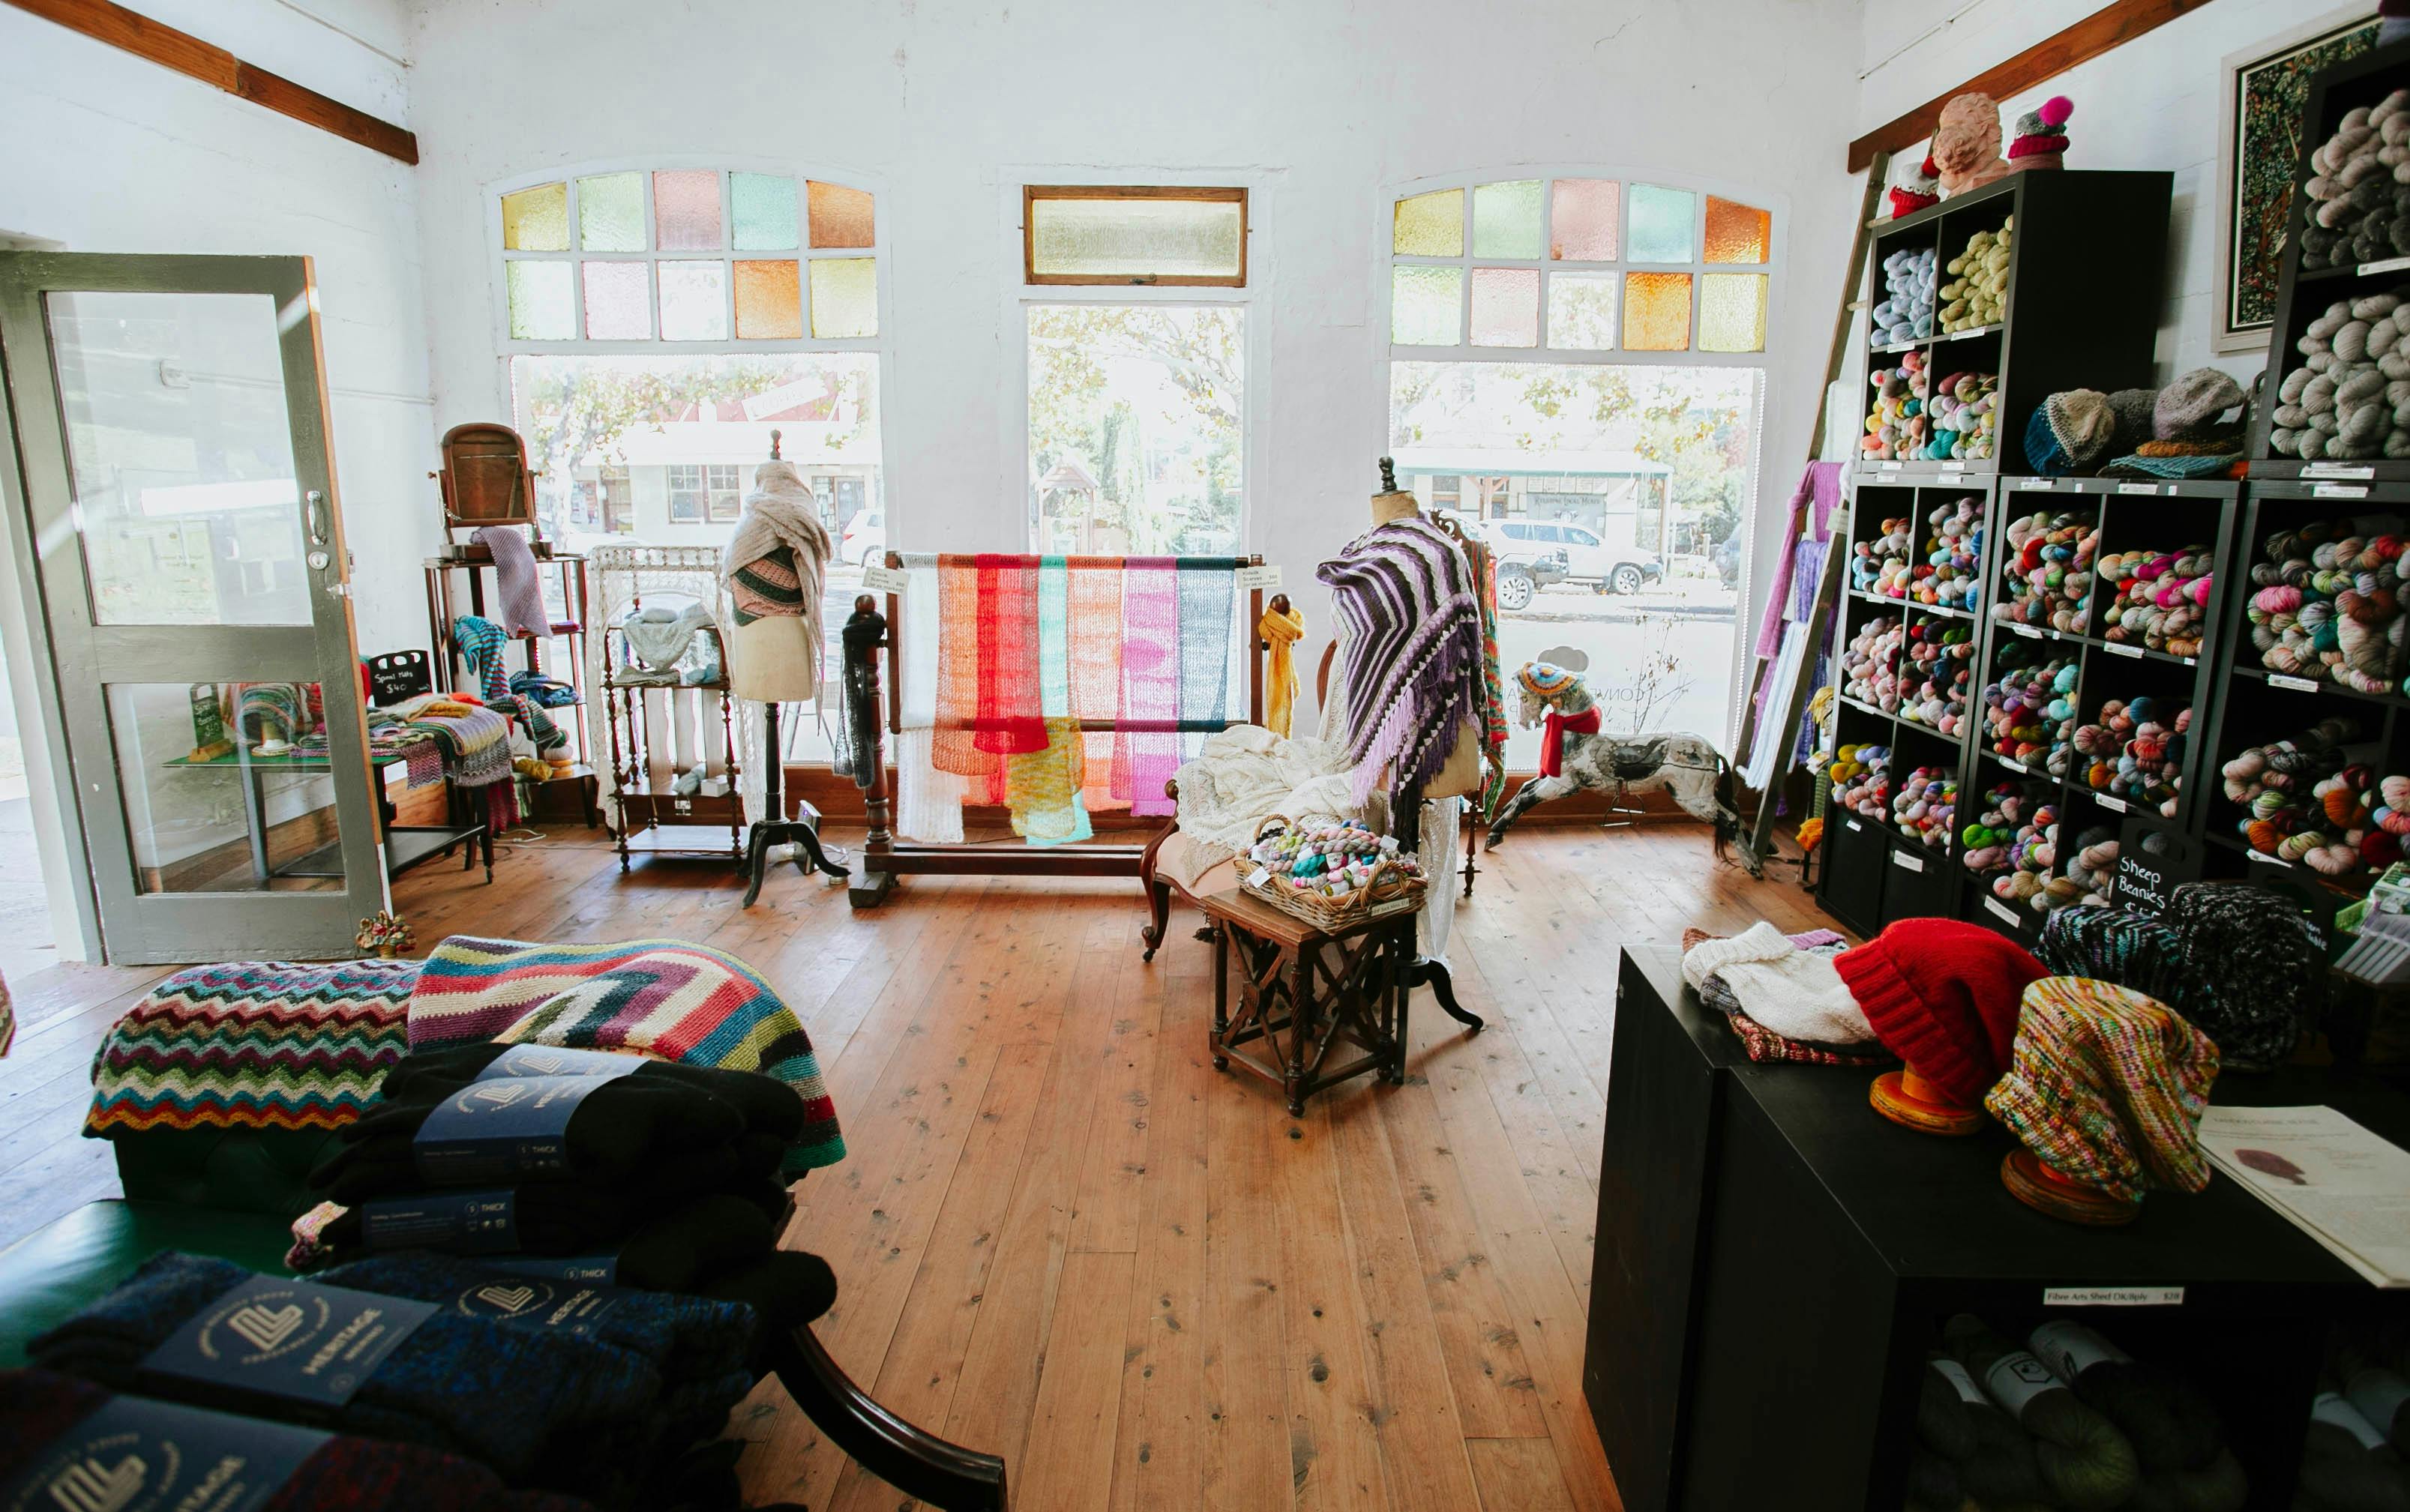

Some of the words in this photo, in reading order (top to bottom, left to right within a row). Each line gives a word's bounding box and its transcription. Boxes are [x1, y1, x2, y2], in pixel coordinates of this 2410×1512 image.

[385, 683, 406, 693] $40
[2119, 856, 2161, 891] Sheep
[2118, 875, 2166, 909] Beanies
[531, 1145, 557, 1154] THICK
[480, 1202, 505, 1211] THICK
[580, 1268, 607, 1278] THICK
[2047, 1292, 2069, 1301] Fibre
[2071, 1292, 2088, 1301] Arts
[2089, 1291, 2112, 1300] Shed
[301, 1307, 382, 1376] HERITAGE
